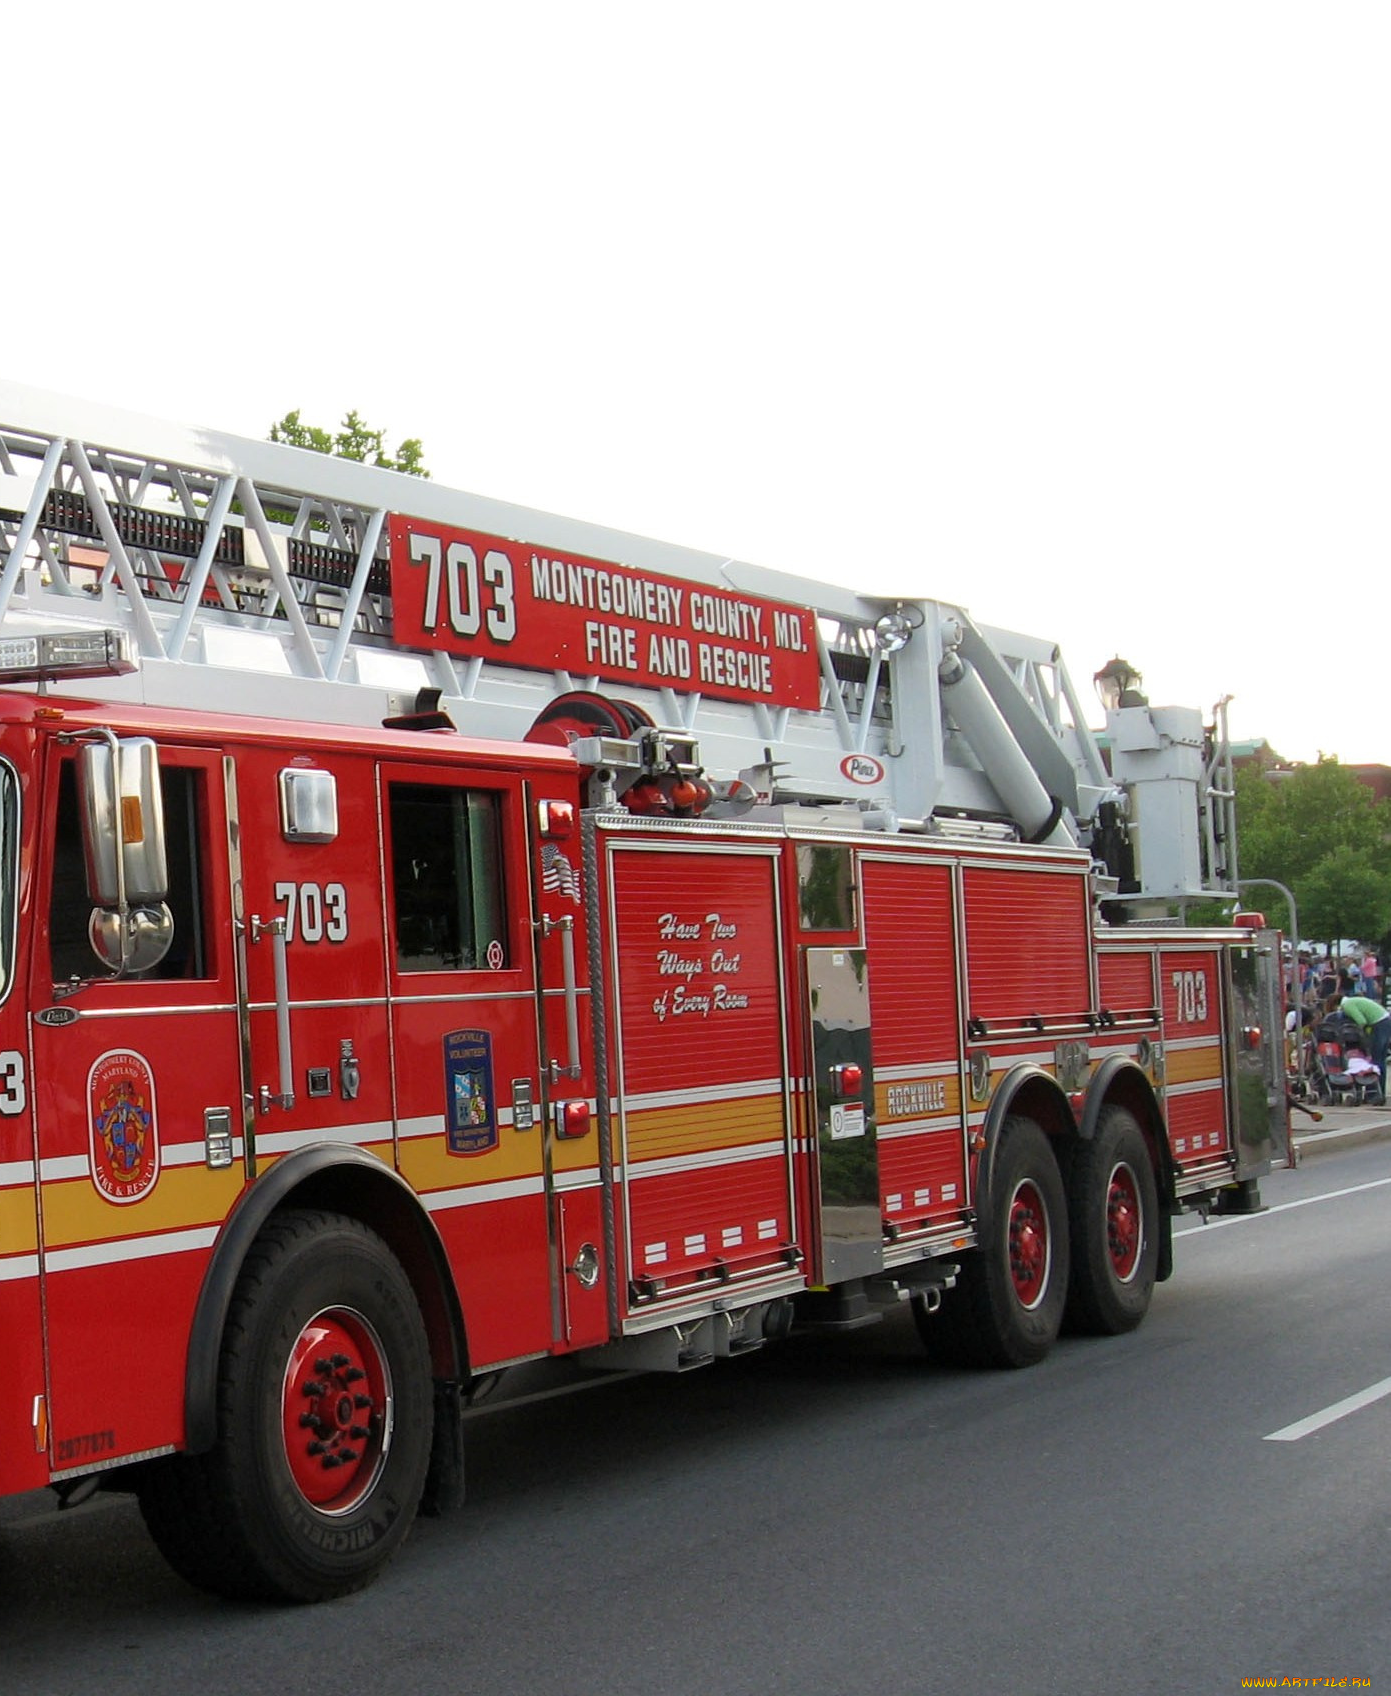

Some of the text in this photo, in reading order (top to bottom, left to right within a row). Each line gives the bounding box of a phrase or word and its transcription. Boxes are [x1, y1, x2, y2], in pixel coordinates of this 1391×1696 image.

[409, 532, 517, 644] 703
[531, 555, 808, 653] MONTGOMERY COUNTY, MD.
[585, 621, 774, 693] FIRE AND RESCUE
[274, 881, 349, 943] 703
[657, 913, 737, 941] Have Two
[656, 948, 741, 982] Ways Out
[652, 984, 749, 1022] of Every Room
[1172, 971, 1208, 1022] 703
[888, 1081, 946, 1115] ROCKVILLE
